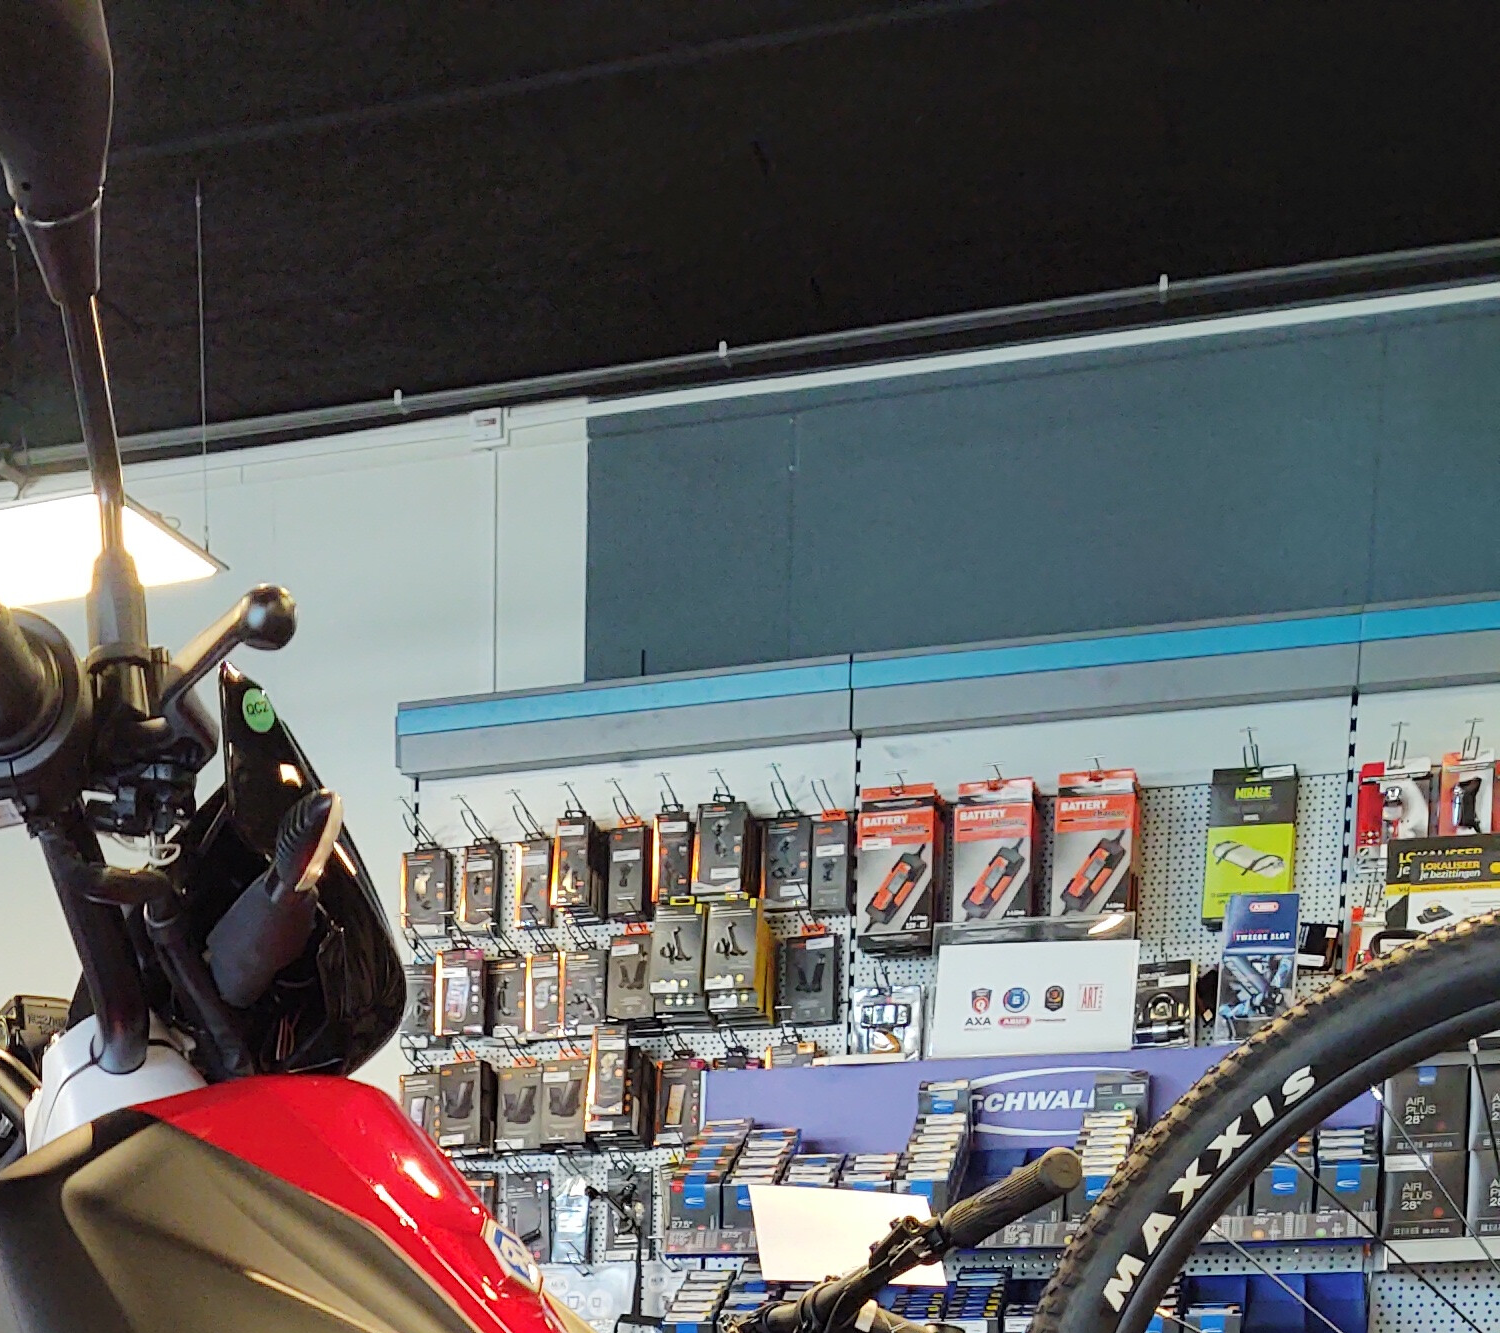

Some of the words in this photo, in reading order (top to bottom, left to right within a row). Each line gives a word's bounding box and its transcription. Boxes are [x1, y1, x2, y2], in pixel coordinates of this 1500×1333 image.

[1236, 785, 1272, 799] MIRAGE
[1060, 800, 1108, 813] BATTERY
[960, 808, 1006, 822] BATTERY
[862, 814, 908, 828] BATTERY
[1420, 861, 1480, 871] LOKALISEER
[1419, 870, 1429, 881] je
[1430, 869, 1481, 879] bezittingen
[965, 1017, 991, 1026] AXA
[1405, 1096, 1425, 1106] AIR
[1405, 1105, 1436, 1115] PLUS
[1103, 1065, 1316, 1312] MAXXIS
[1402, 1182, 1422, 1192] AIR
[1401, 1191, 1433, 1201] PLUS
